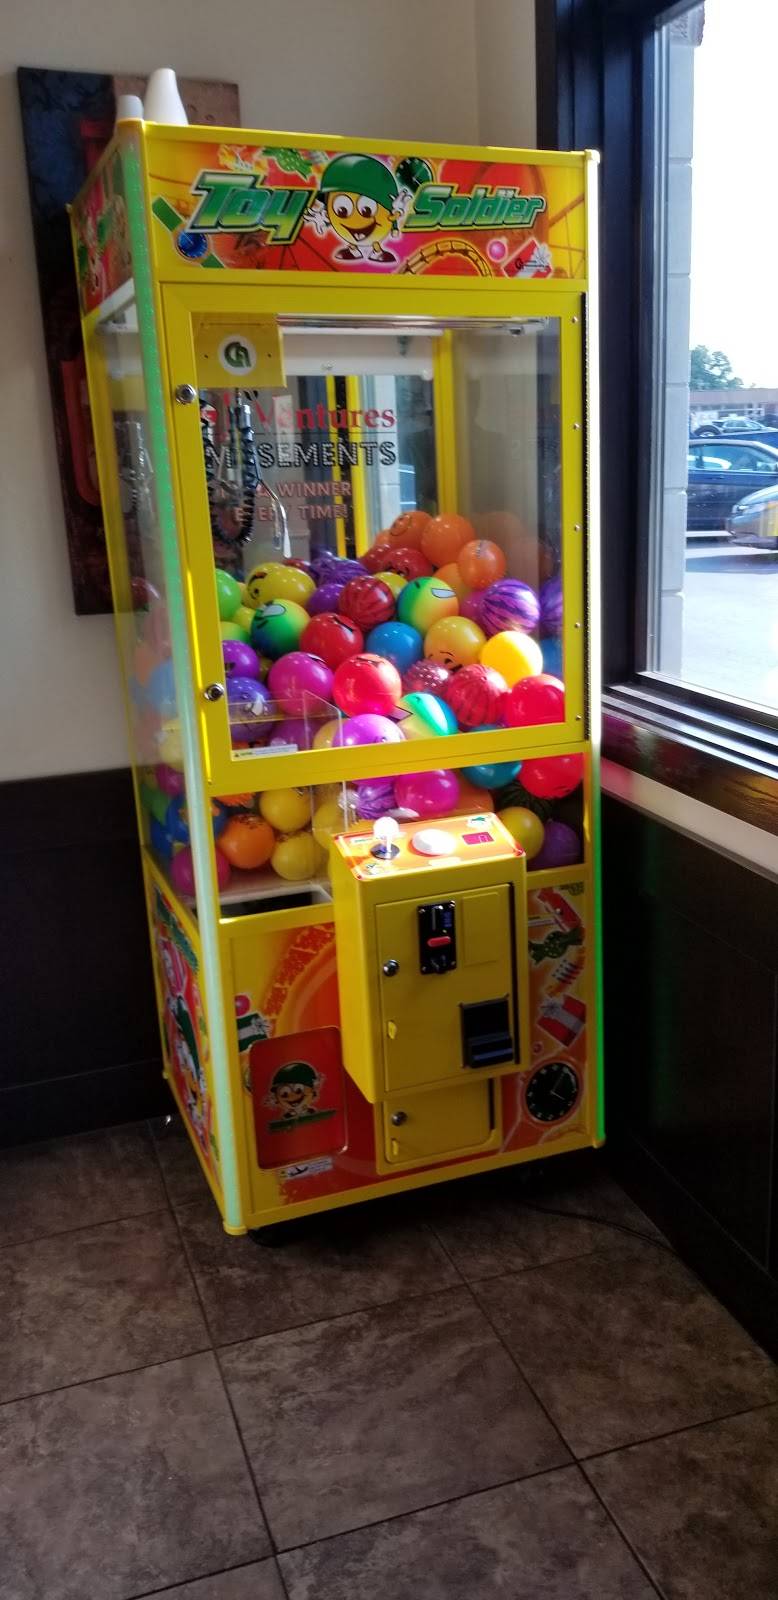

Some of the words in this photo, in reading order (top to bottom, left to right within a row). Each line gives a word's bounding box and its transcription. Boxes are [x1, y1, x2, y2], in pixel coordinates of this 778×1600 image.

[190, 172, 315, 243] Toy
[408, 186, 547, 230] Soldier
[253, 399, 396, 430] Ventures
[276, 481, 353, 498] WINNER
